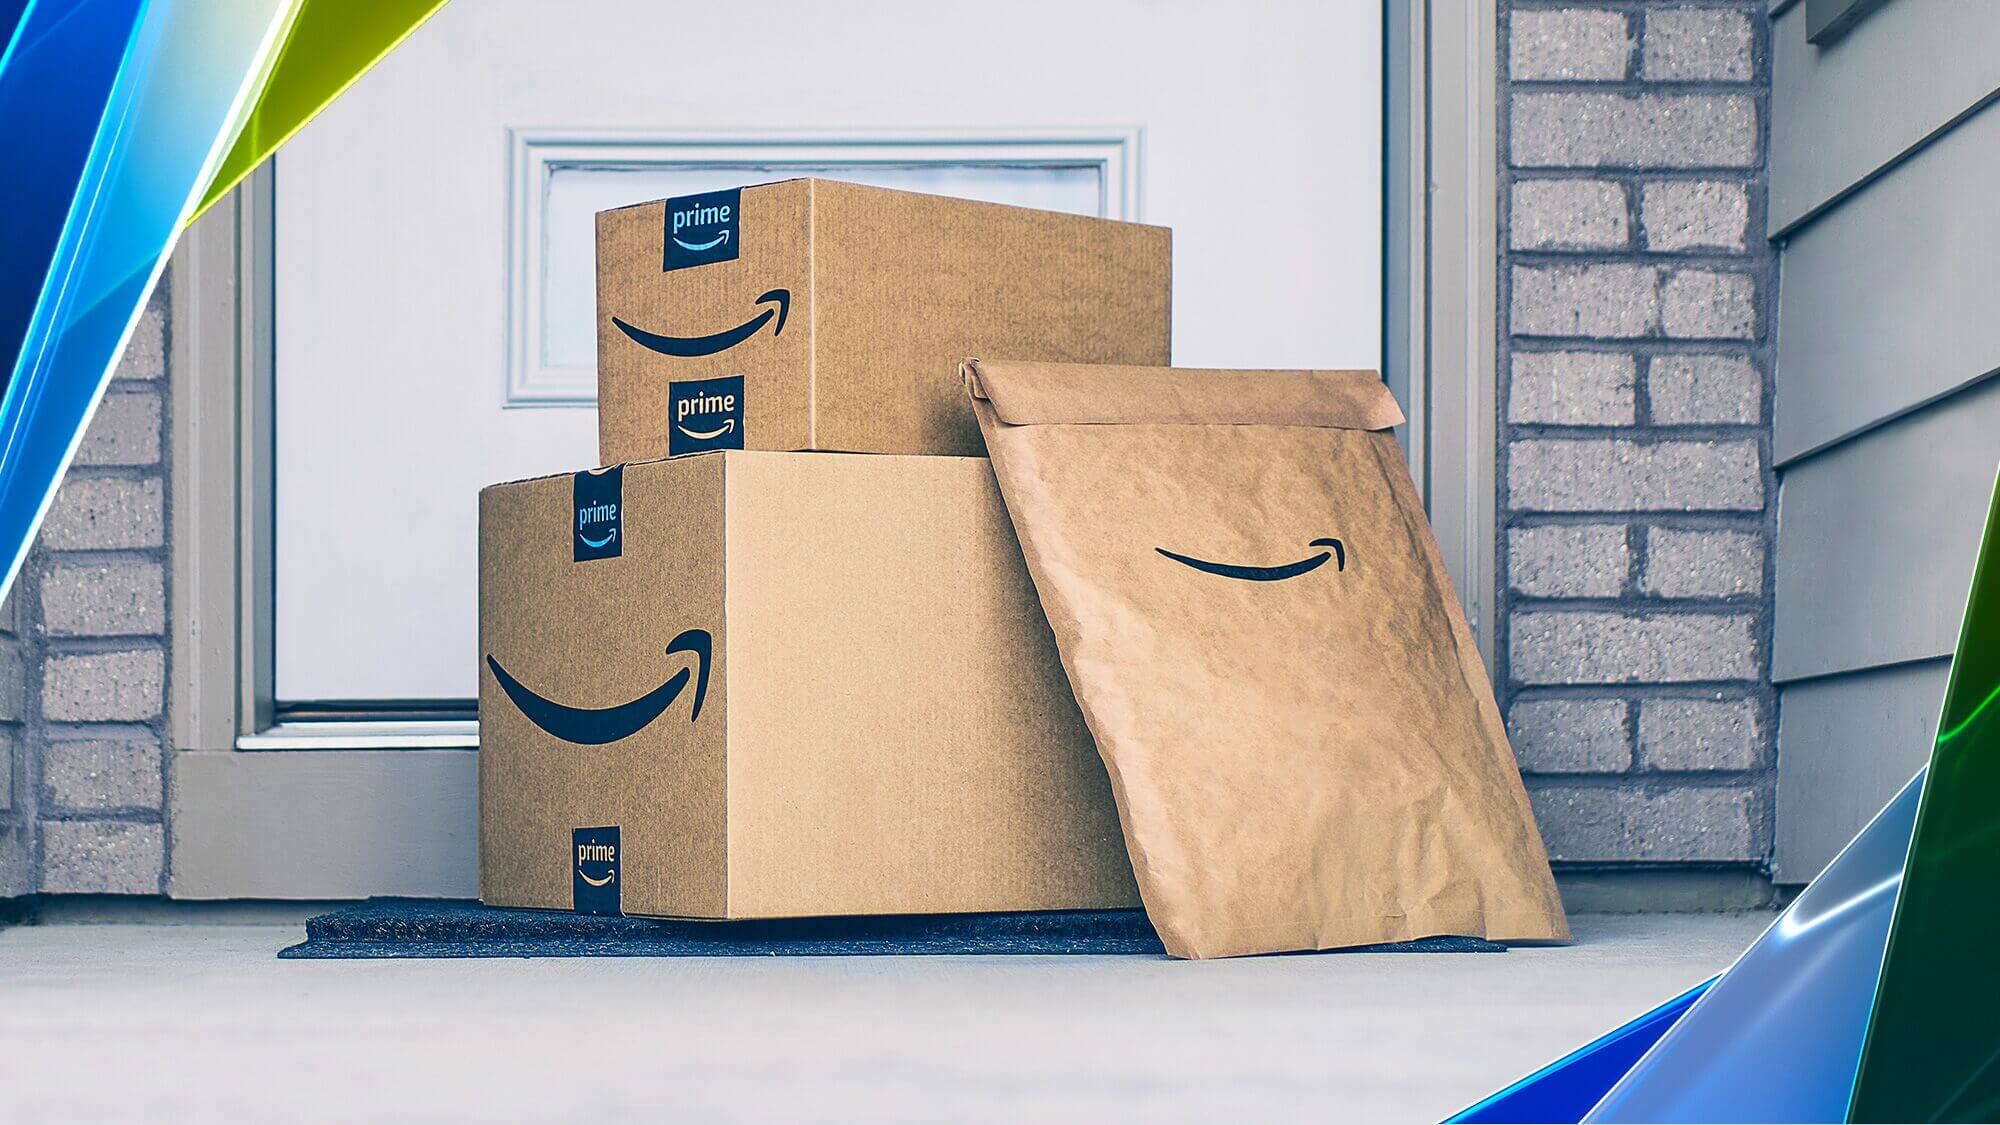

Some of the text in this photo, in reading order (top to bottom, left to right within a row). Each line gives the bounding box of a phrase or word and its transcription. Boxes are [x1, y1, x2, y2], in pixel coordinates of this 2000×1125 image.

[673, 202, 731, 235] prime
[677, 390, 735, 422] prime
[579, 499, 617, 530] prime
[577, 838, 615, 867] prime
